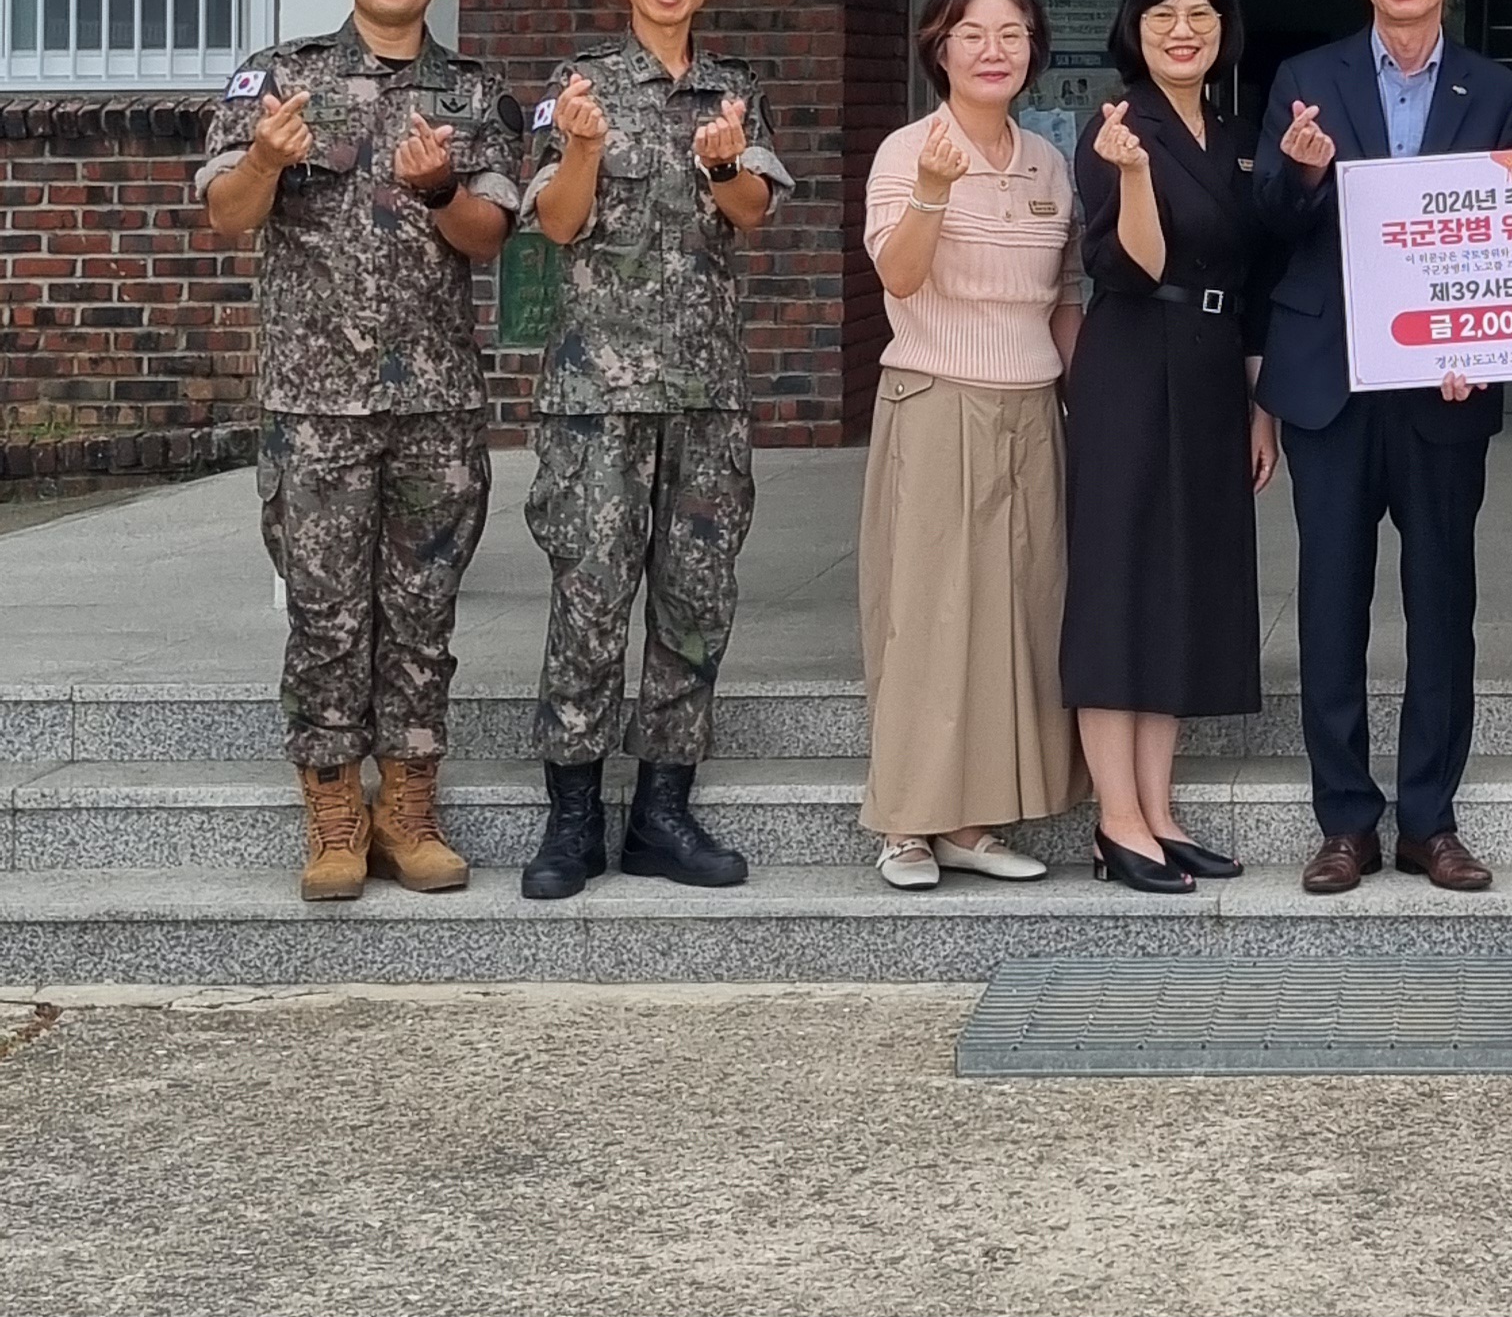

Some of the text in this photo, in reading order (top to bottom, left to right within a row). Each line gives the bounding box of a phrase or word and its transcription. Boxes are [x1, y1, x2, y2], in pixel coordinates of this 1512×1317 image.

[1421, 188, 1497, 215] 2024년
[1382, 215, 1492, 248] 국군장병
[1405, 253, 1415, 264] 이
[1429, 314, 1452, 339] 금
